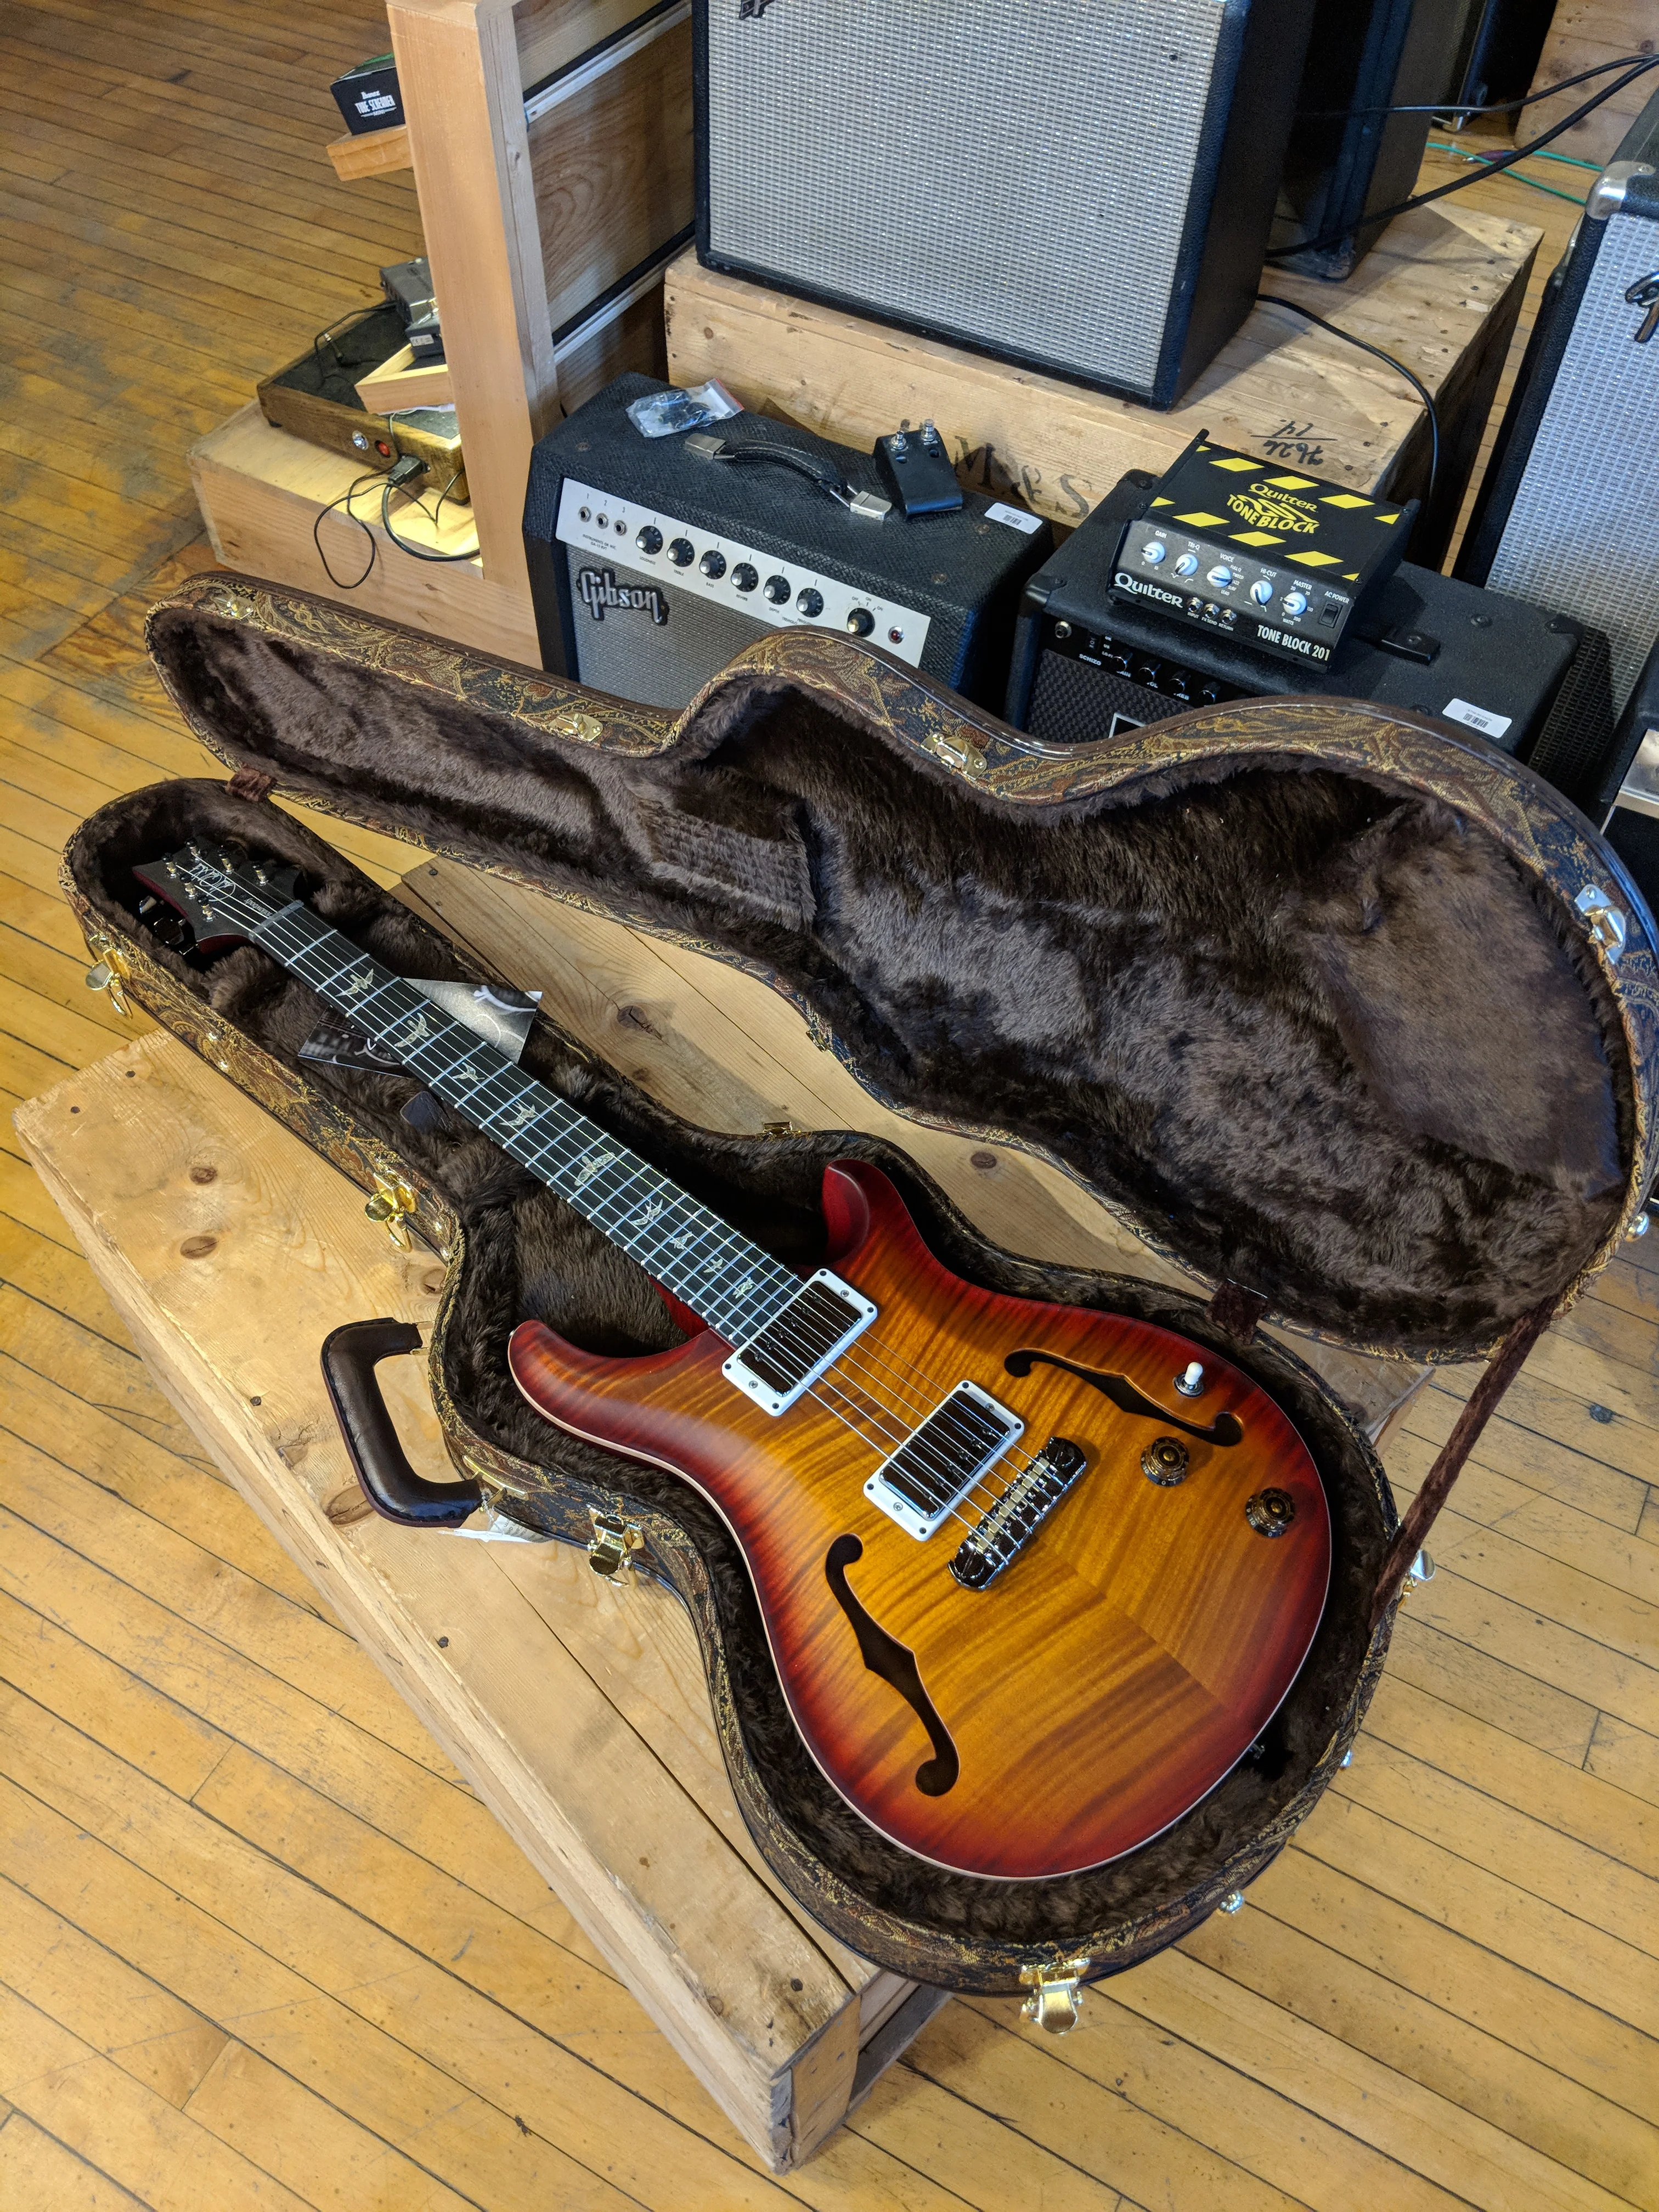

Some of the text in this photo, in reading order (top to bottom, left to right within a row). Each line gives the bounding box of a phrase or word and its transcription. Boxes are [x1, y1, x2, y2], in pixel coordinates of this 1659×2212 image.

[1248, 483, 1318, 513] Quilter
[1227, 494, 1320, 534] TONE BLOCK
[1155, 530, 1167, 538] GAIN
[1188, 541, 1200, 551] TRI-Q
[639, 556, 656, 565] LOUDNESS
[1220, 553, 1234, 563] VOICE
[1260, 567, 1277, 578] HI-CUT
[1114, 572, 1183, 608] Quilter
[1293, 579, 1312, 590] MASTER
[580, 571, 662, 623] Gibson
[1331, 593, 1351, 603] POWER
[1218, 622, 1234, 631] RETURN
[1257, 625, 1330, 661] TONE BLOCK 201
[1079, 653, 1102, 666] SCHIZO
